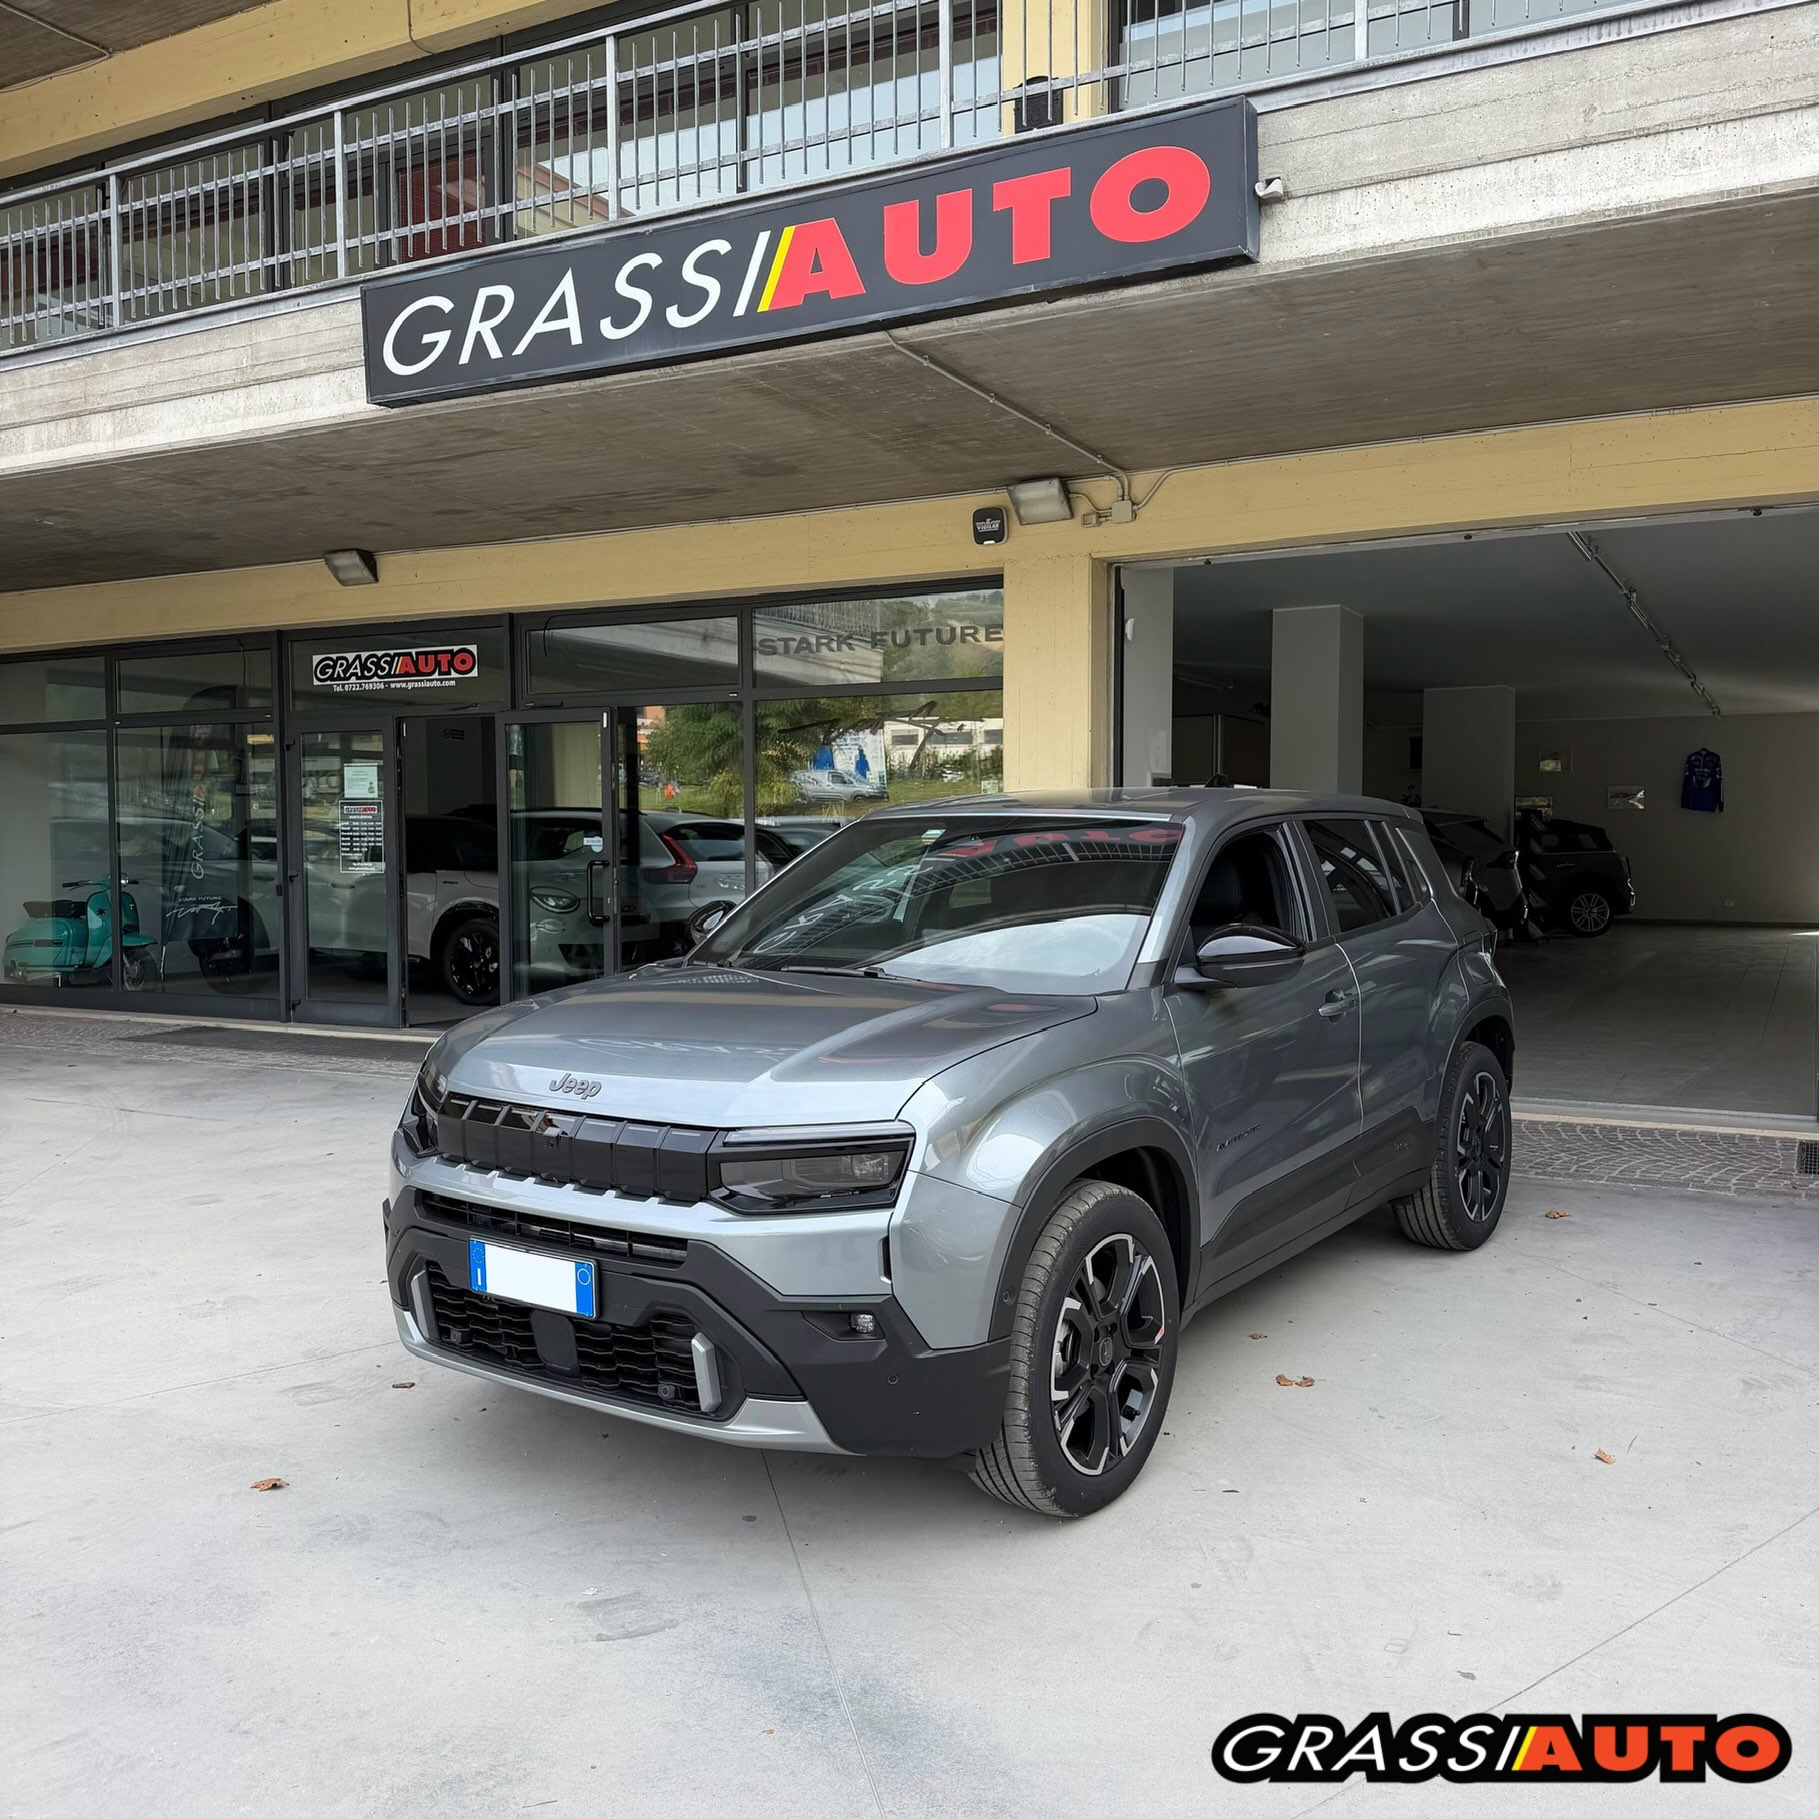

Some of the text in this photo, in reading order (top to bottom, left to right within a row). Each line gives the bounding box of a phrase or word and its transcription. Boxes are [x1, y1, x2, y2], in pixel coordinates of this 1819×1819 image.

[758, 624, 1004, 656] STARK FUTURE
[333, 684, 344, 692] Tel.
[344, 682, 385, 692] 0722.769306
[390, 679, 456, 691] www.grassiauto.com
[549, 1073, 602, 1100] Jeep
